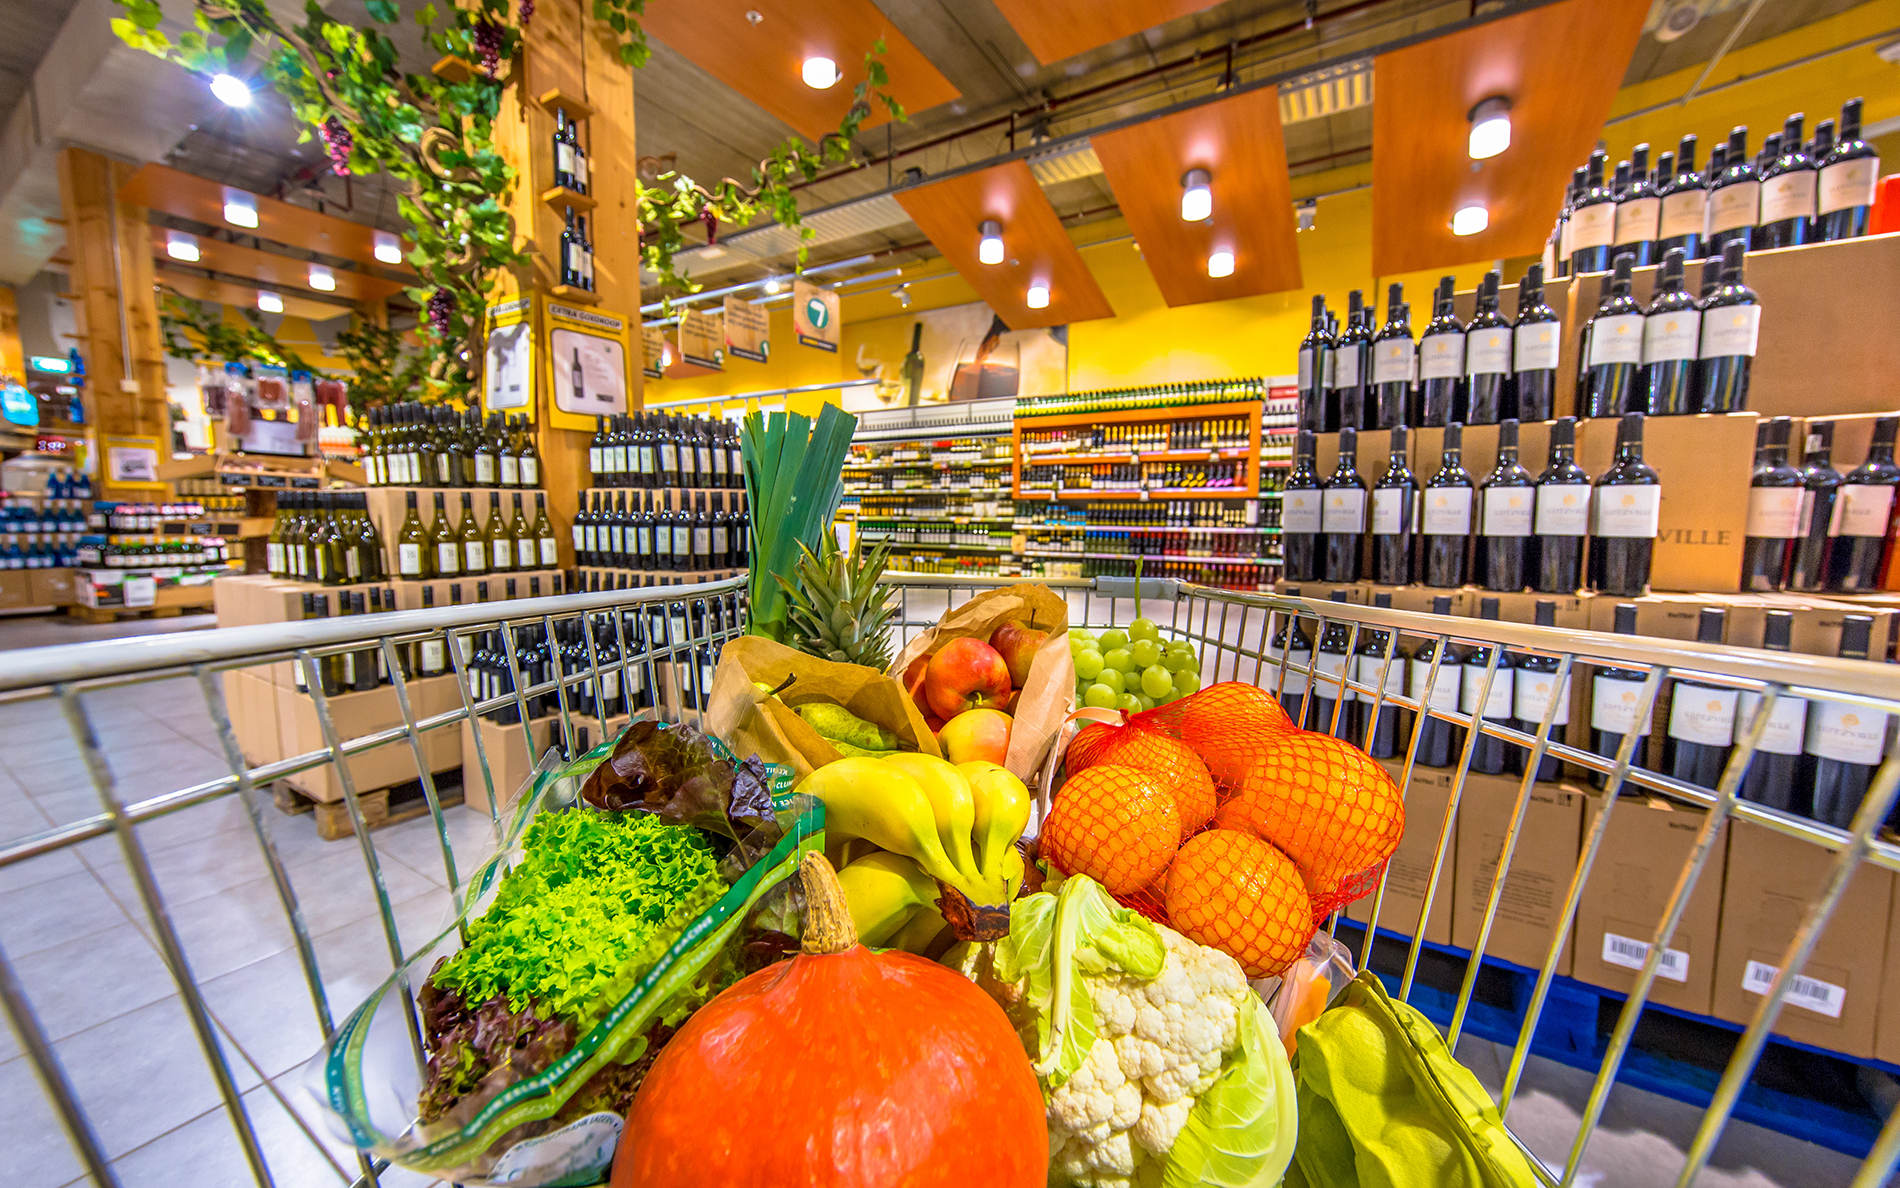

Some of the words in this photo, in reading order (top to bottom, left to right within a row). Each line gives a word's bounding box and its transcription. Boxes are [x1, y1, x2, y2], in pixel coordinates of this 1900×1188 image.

[810, 300, 825, 327] 7
[1657, 529, 1731, 545] VILLE
[775, 779, 793, 788] CLUM
[605, 985, 643, 1029] LAITUE
[646, 953, 672, 986] AVEC
